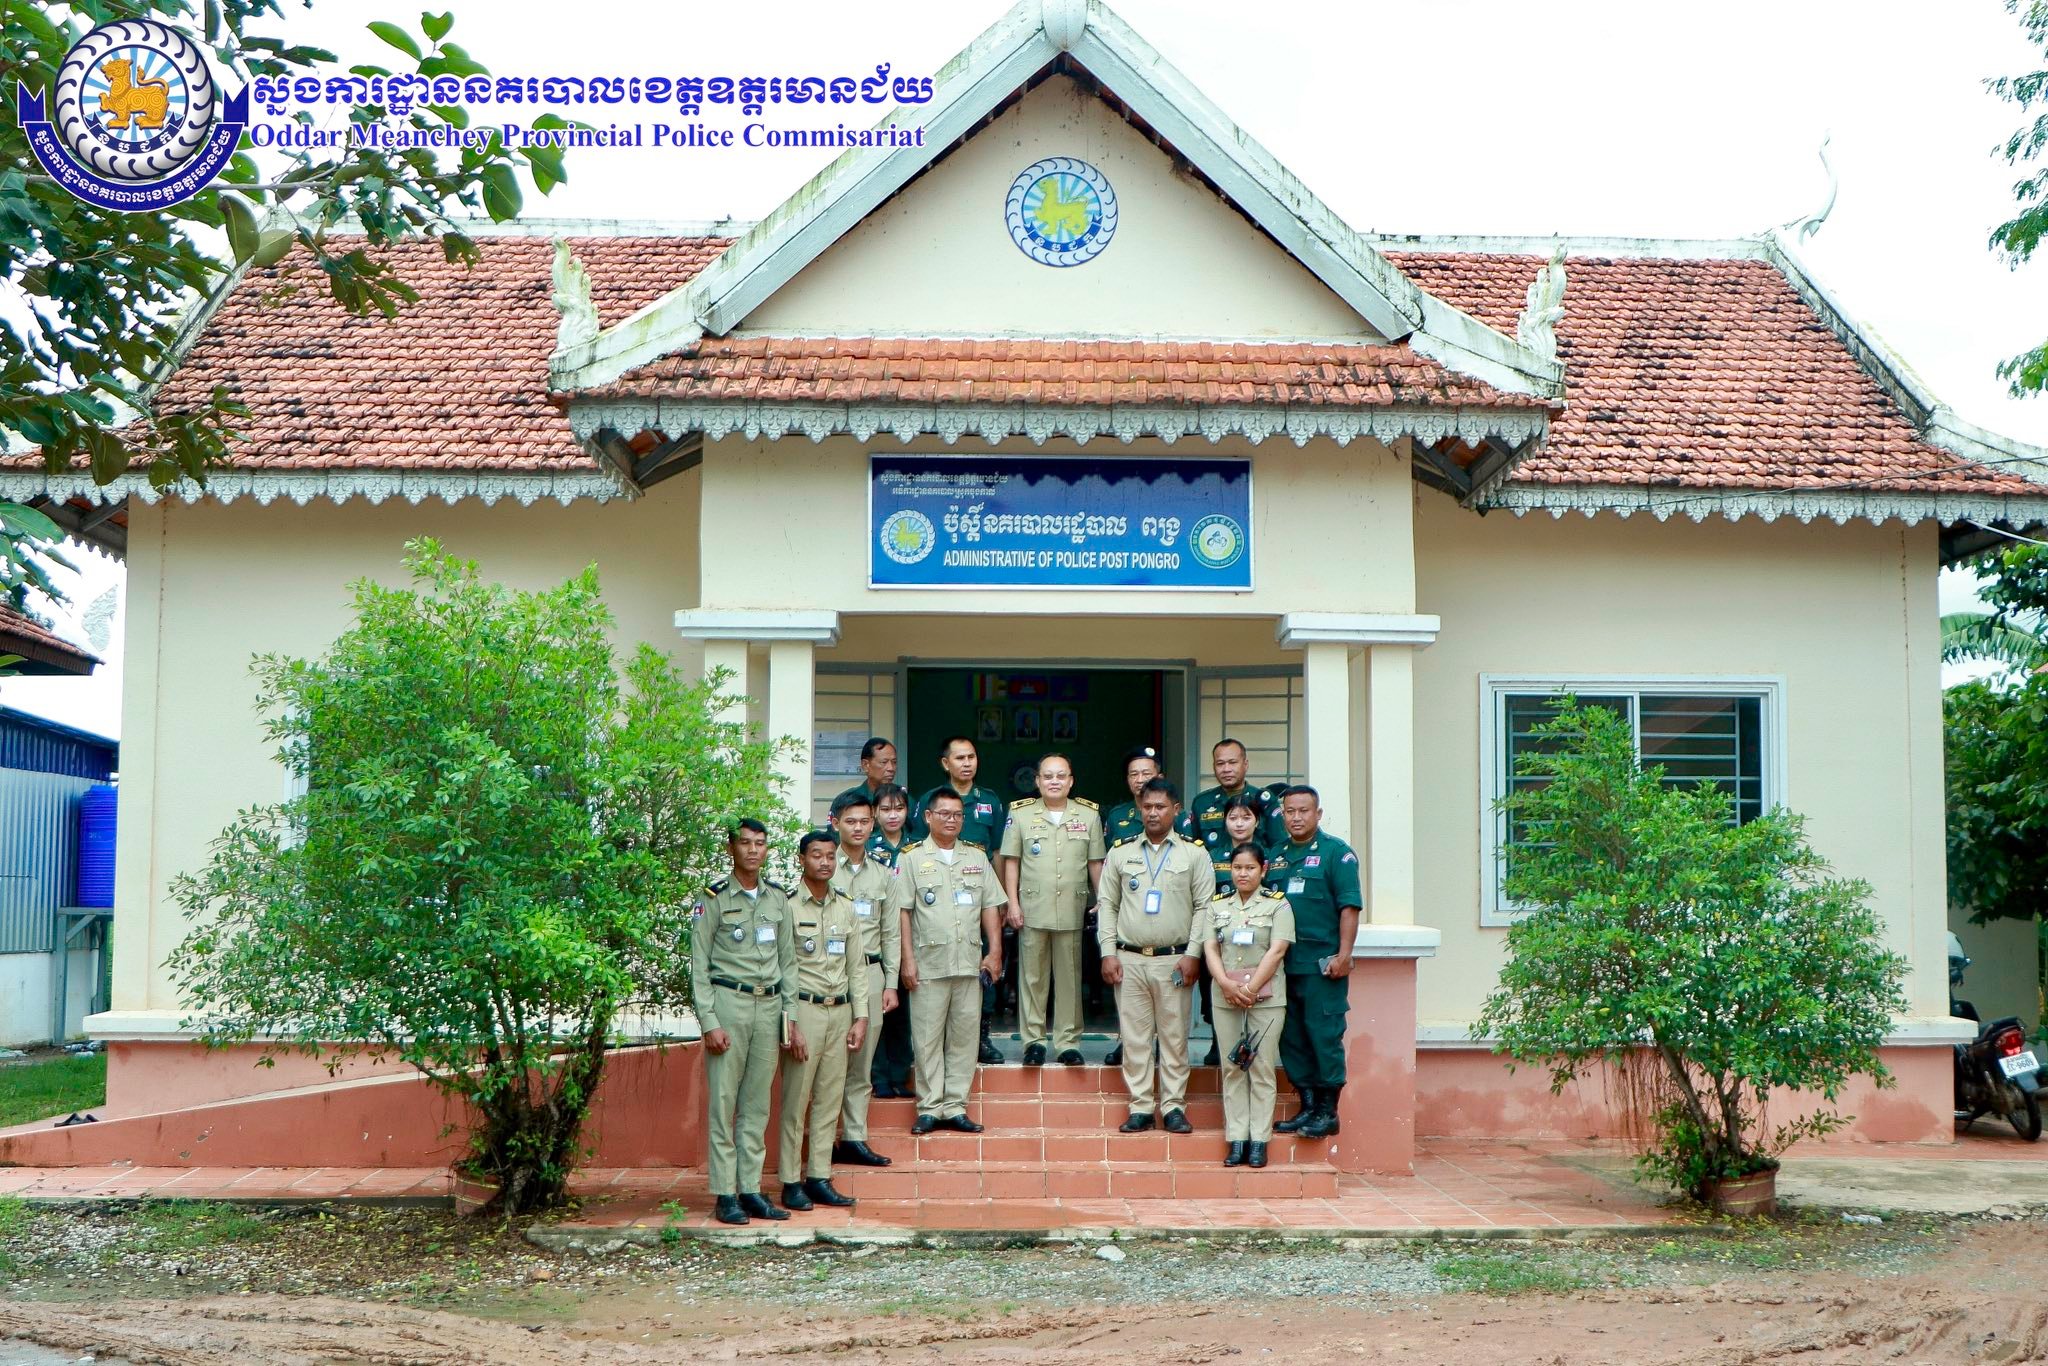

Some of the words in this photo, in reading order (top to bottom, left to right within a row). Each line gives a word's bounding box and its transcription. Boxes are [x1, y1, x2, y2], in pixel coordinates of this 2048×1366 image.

[943, 550, 1035, 567] ADMINISTRATIVE
[1039, 550, 1054, 567] OF
[1056, 551, 1097, 568] POLICE
[1100, 551, 1129, 568] POST
[1132, 552, 1180, 569] PONGRO
